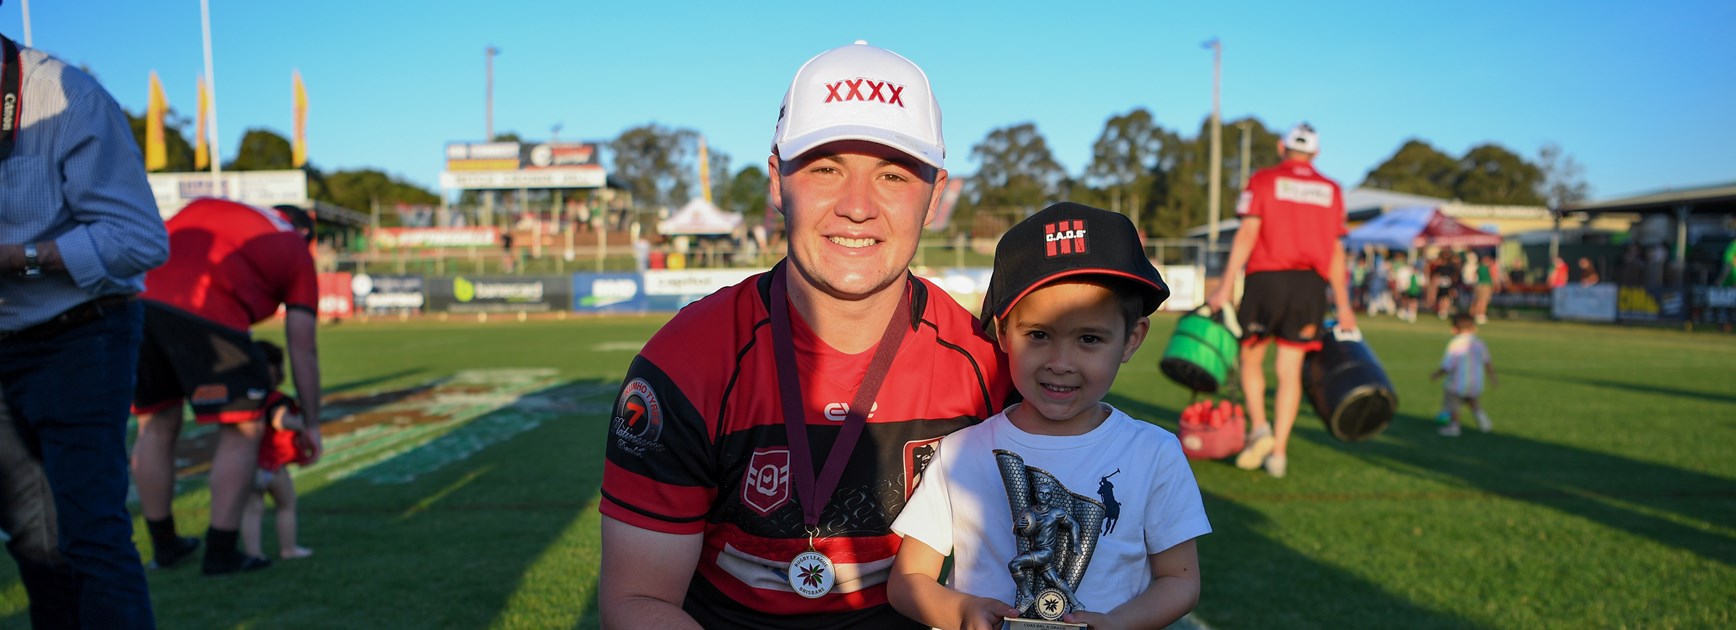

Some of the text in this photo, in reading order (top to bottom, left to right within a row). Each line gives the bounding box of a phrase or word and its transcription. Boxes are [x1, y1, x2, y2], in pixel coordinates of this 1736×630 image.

[824, 78, 905, 108] XXXX
[625, 382, 647, 397] KUMHO
[794, 555, 828, 567] RUGBY LEAGUE
[799, 586, 825, 595] BRISBANE
